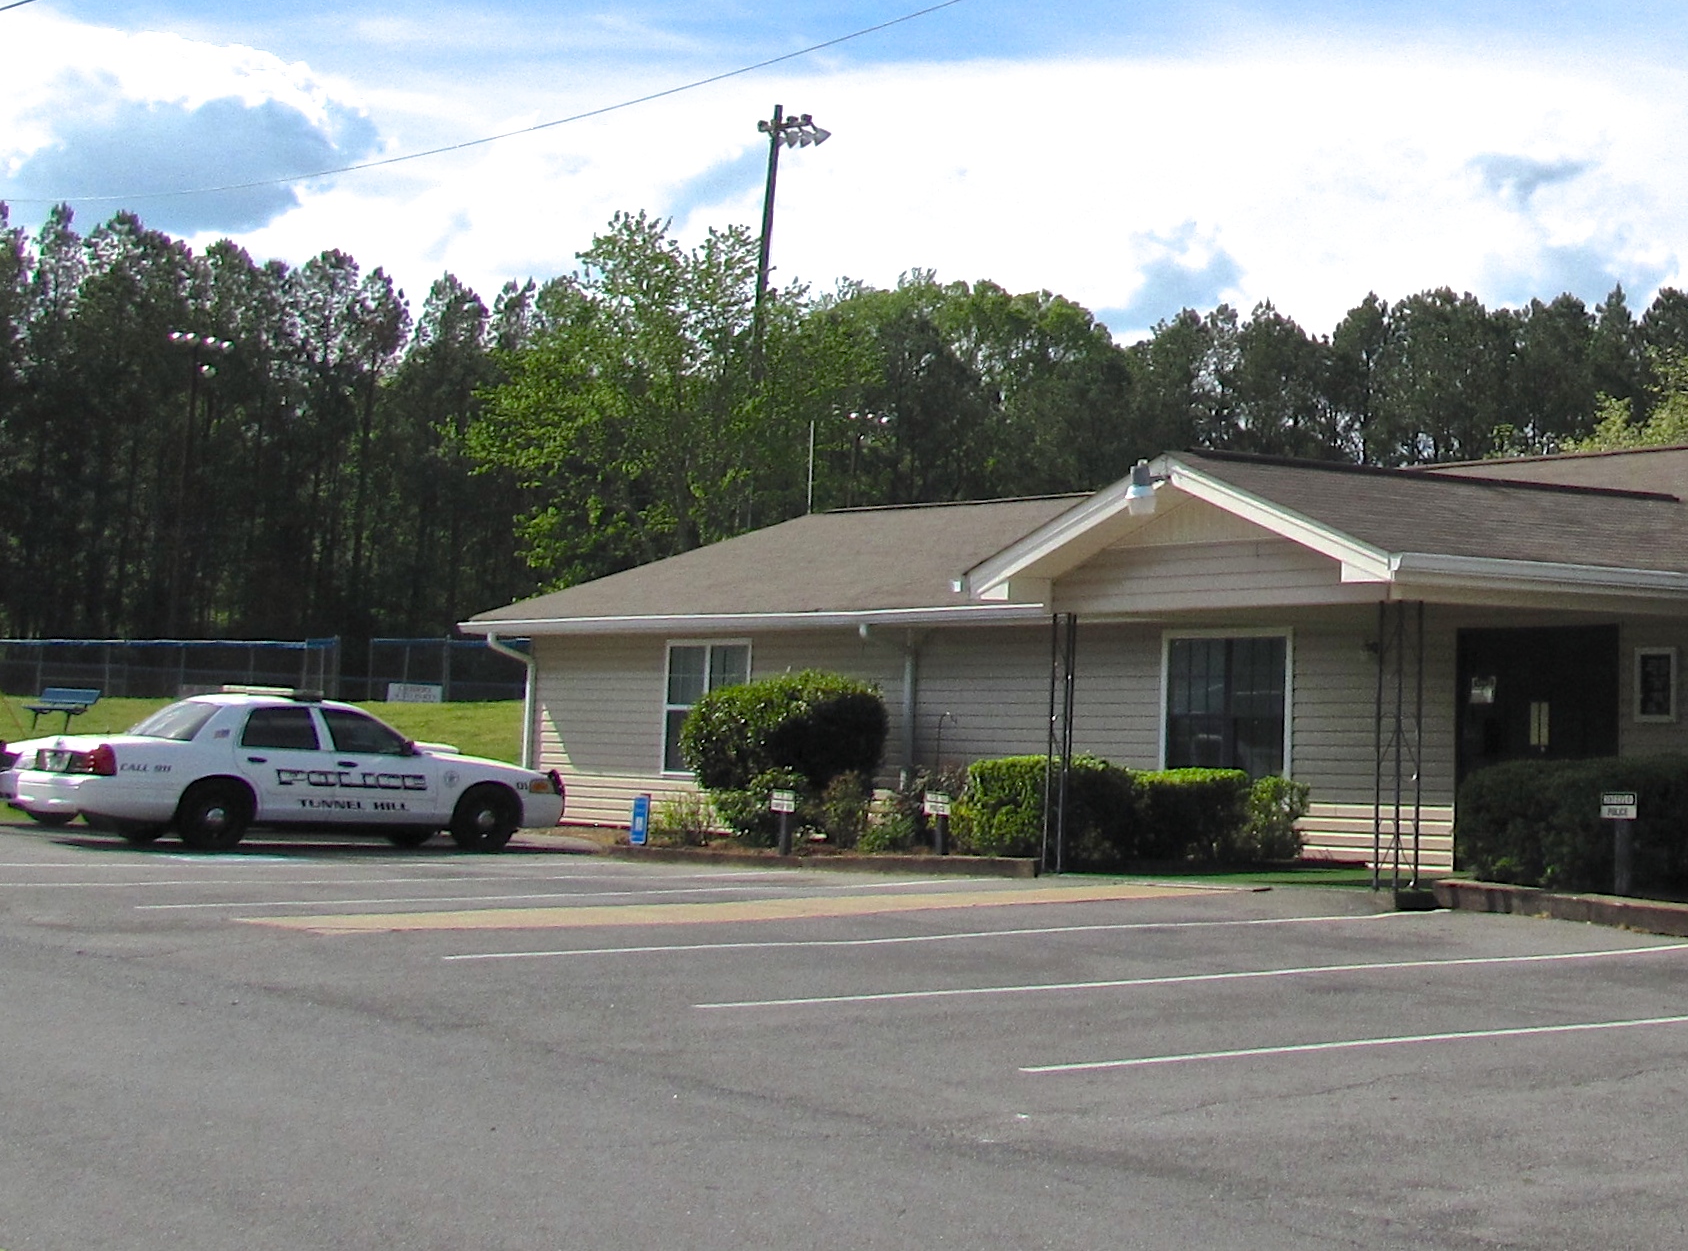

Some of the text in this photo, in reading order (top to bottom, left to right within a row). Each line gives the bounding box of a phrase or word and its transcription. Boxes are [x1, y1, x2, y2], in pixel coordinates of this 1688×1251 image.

[120, 763, 173, 773] CALL 911
[276, 768, 429, 791] POLICE
[298, 798, 411, 812] TUNNEL HILL
